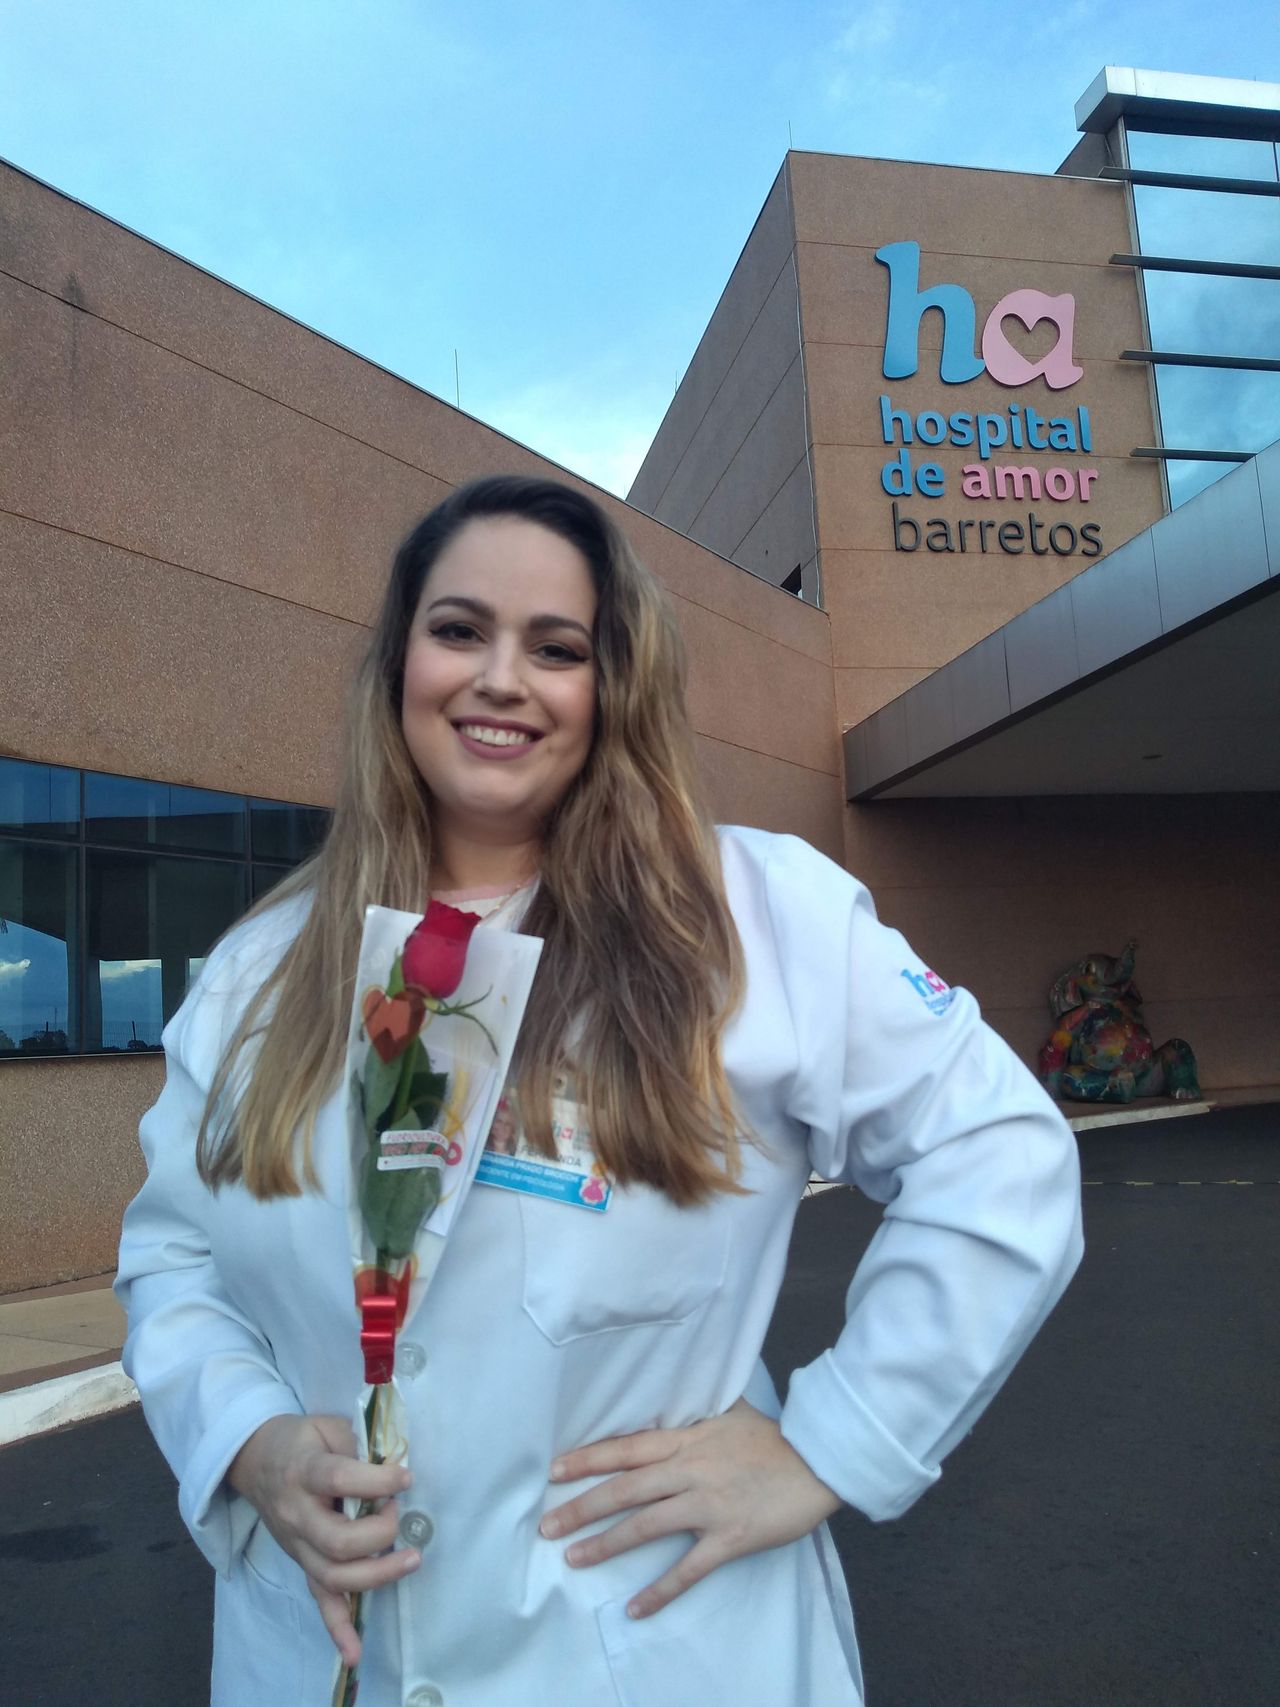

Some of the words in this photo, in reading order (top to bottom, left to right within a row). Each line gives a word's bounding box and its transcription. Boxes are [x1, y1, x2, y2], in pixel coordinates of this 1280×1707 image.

[874, 240, 1084, 390] ha
[880, 395, 1094, 459] hospital
[881, 448, 945, 497] de
[961, 463, 1098, 501] amor
[892, 501, 1103, 556] barretos
